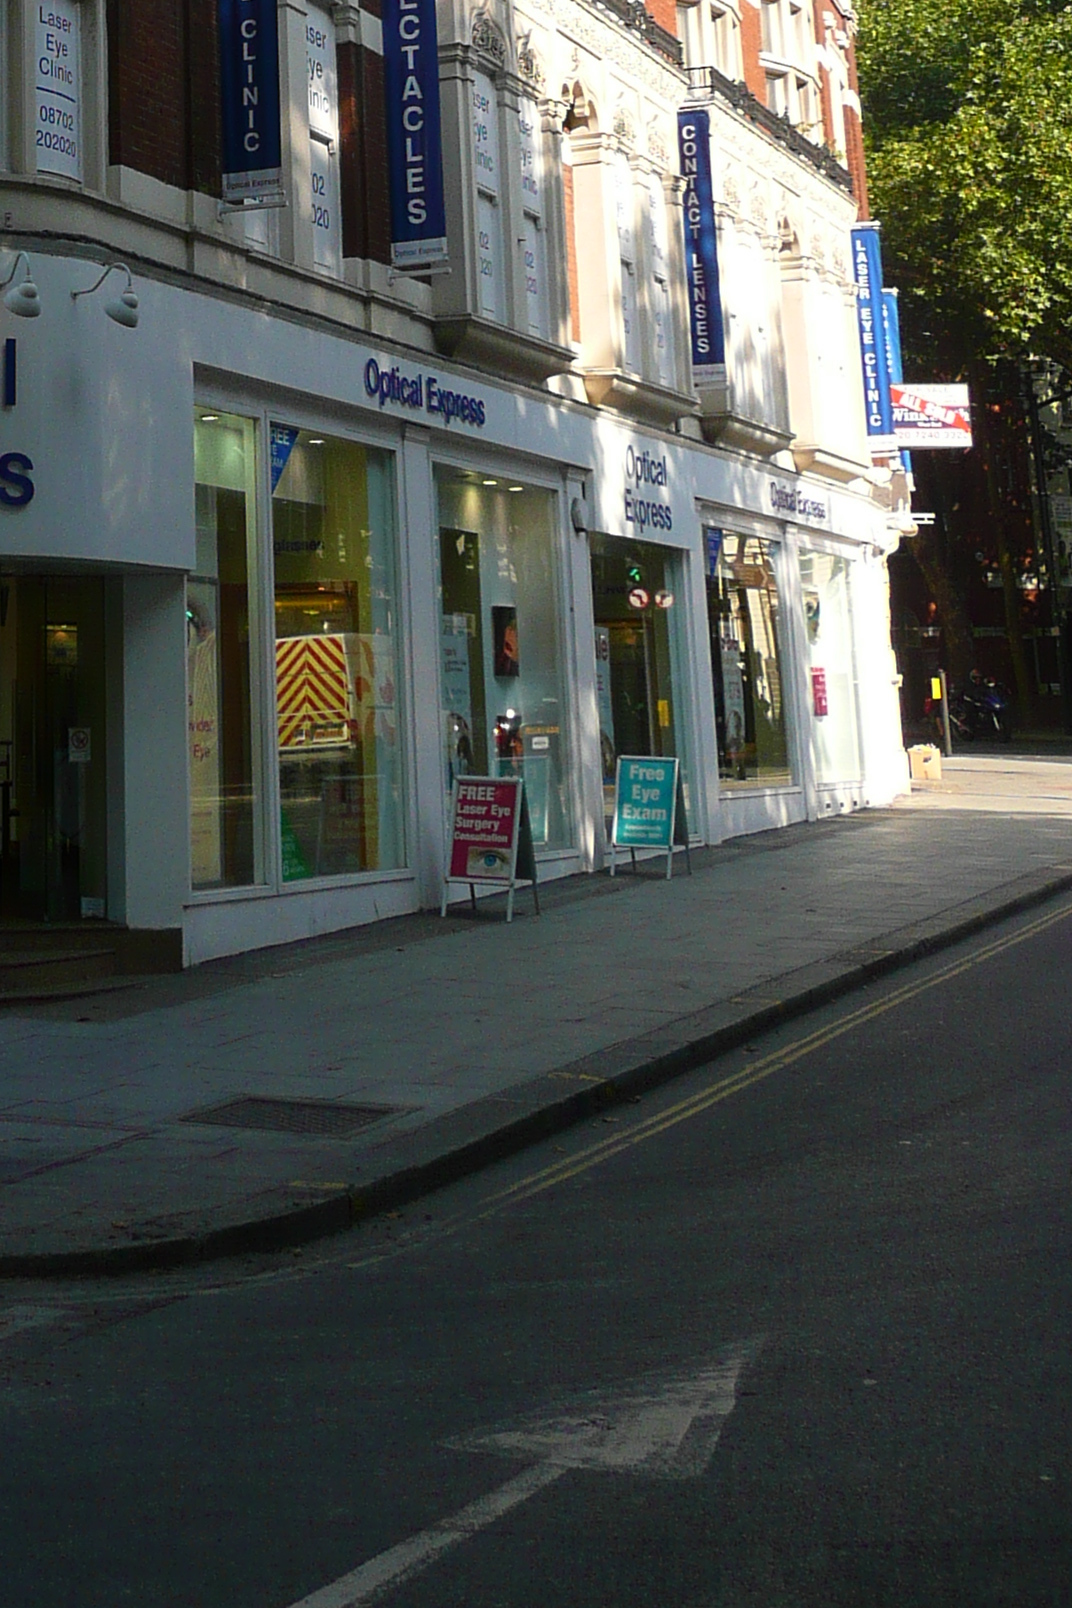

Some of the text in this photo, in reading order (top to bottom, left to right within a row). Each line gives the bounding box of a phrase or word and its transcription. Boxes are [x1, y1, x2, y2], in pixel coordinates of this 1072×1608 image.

[39, 6, 71, 33] Laser
[46, 34, 68, 59] Eye
[39, 58, 73, 84] Clinic
[241, 19, 259, 152] CLINIC
[39, 106, 74, 131] 08702
[36, 130, 77, 158] 202020
[682, 124, 702, 240] CONTACT
[692, 254, 710, 353] LENSES
[855, 240, 882, 427] LASER EYE CLINIC
[364, 358, 485, 426] Optical Express
[899, 393, 923, 412] ALL
[626, 445, 667, 489] Optical
[624, 488, 672, 533] Express
[193, 743, 211, 762] Eye
[629, 764, 665, 781] Free
[458, 786, 495, 801] FREE
[632, 784, 660, 803] Eye
[457, 802, 511, 818] Laser Eye
[622, 803, 667, 820] Exam
[455, 816, 500, 831] Surgery
[454, 832, 508, 843] Consultation
